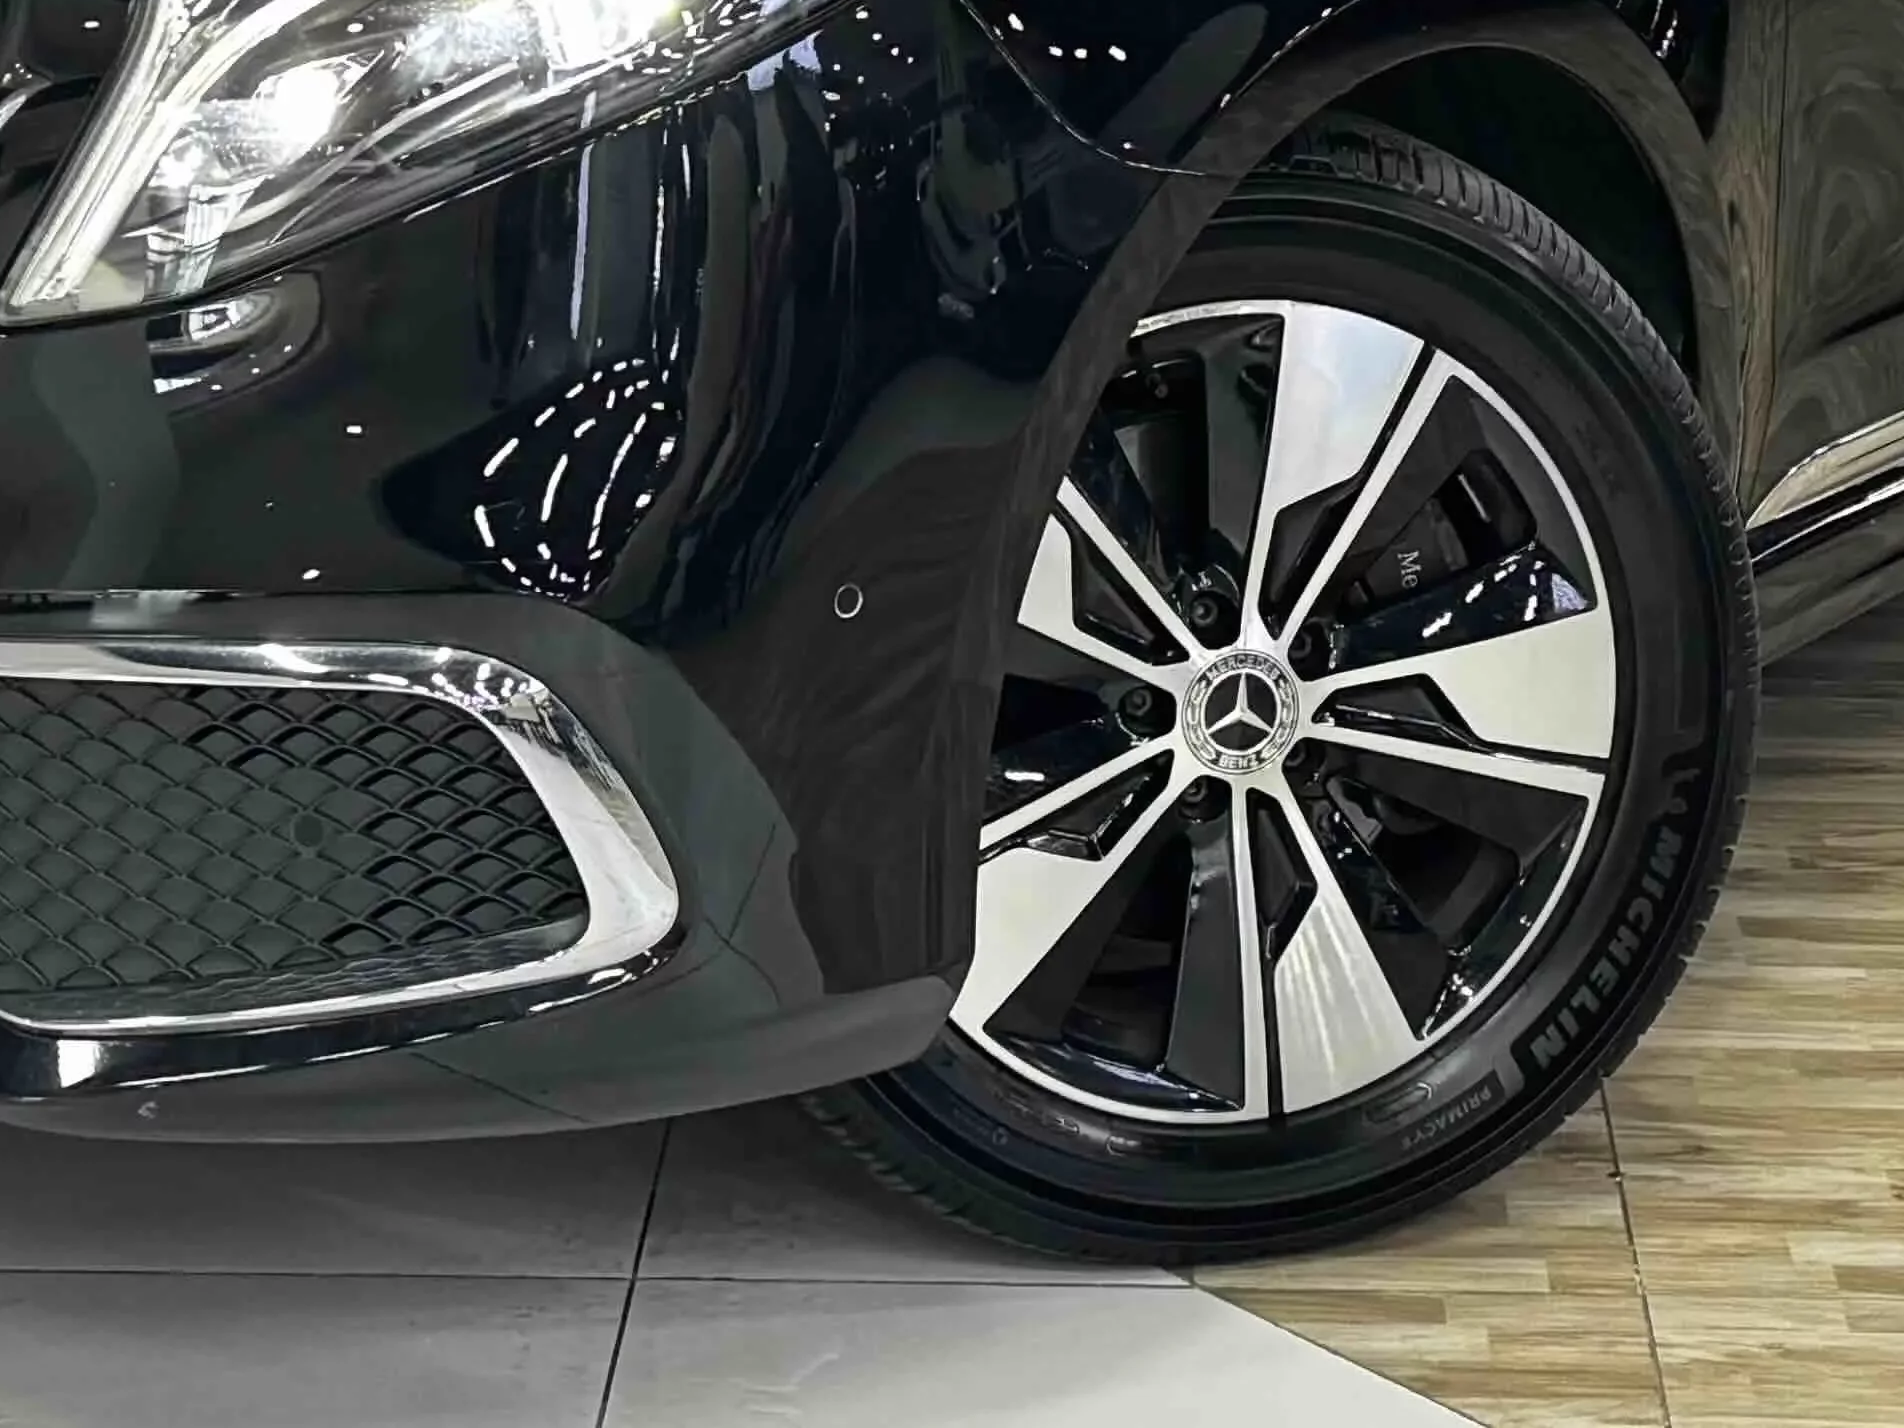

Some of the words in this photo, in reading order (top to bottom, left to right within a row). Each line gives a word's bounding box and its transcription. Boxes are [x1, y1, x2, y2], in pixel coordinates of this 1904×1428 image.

[1205, 654, 1282, 681] MERCEDES
[1217, 753, 1260, 769] BENZ
[1528, 824, 1684, 1070] MICHELIN
